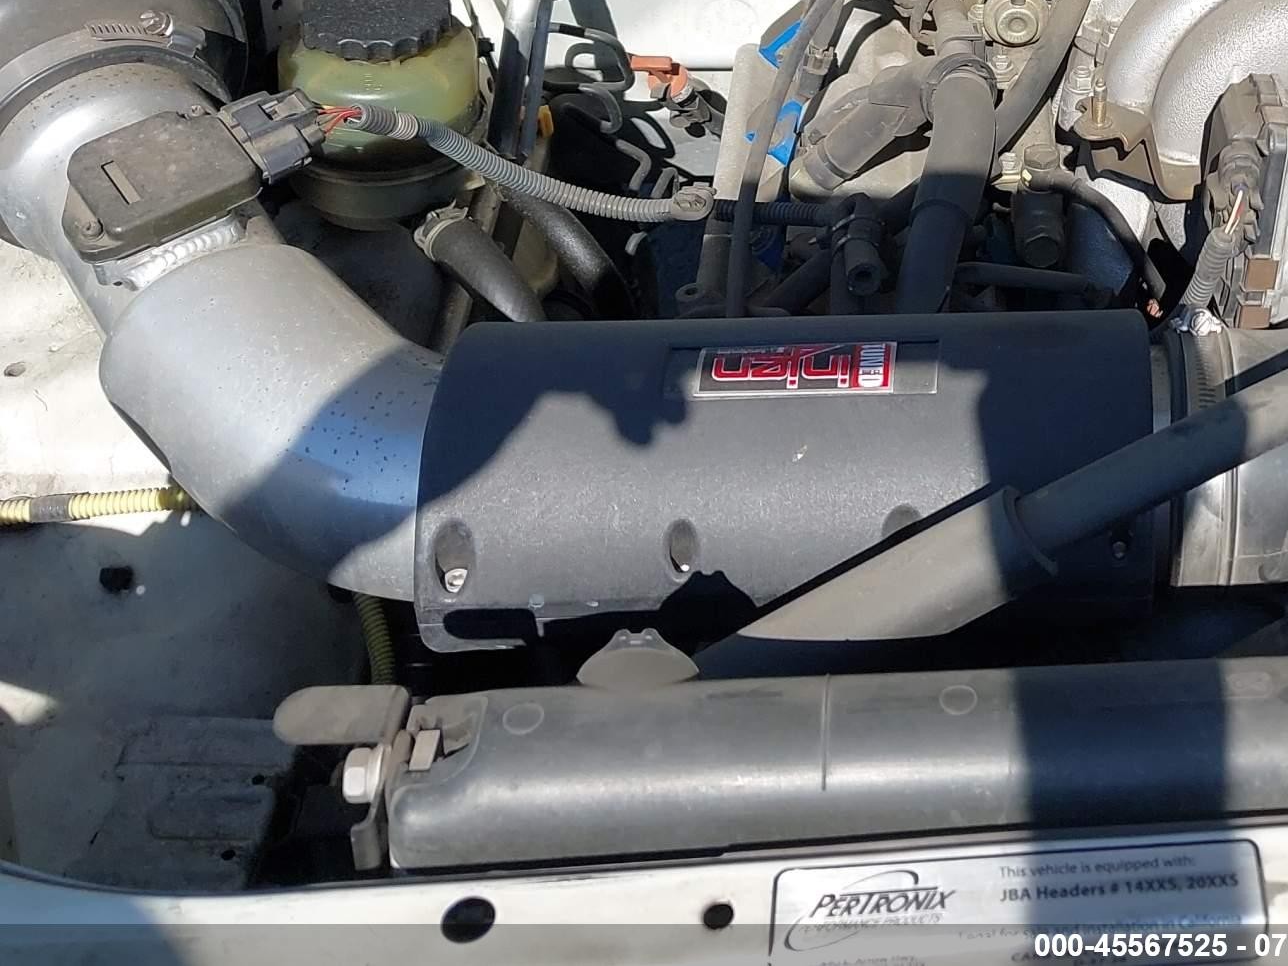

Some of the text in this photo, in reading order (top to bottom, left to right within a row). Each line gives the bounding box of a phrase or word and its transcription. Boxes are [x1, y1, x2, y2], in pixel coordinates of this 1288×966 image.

[711, 348, 850, 390] injen
[859, 343, 886, 388] TUNED
[999, 855, 1196, 880] This vehicle is equipped with:
[809, 886, 957, 919] PERTRONIX
[1000, 873, 1239, 903] JBA Headers # 14XXS, 20XXS
